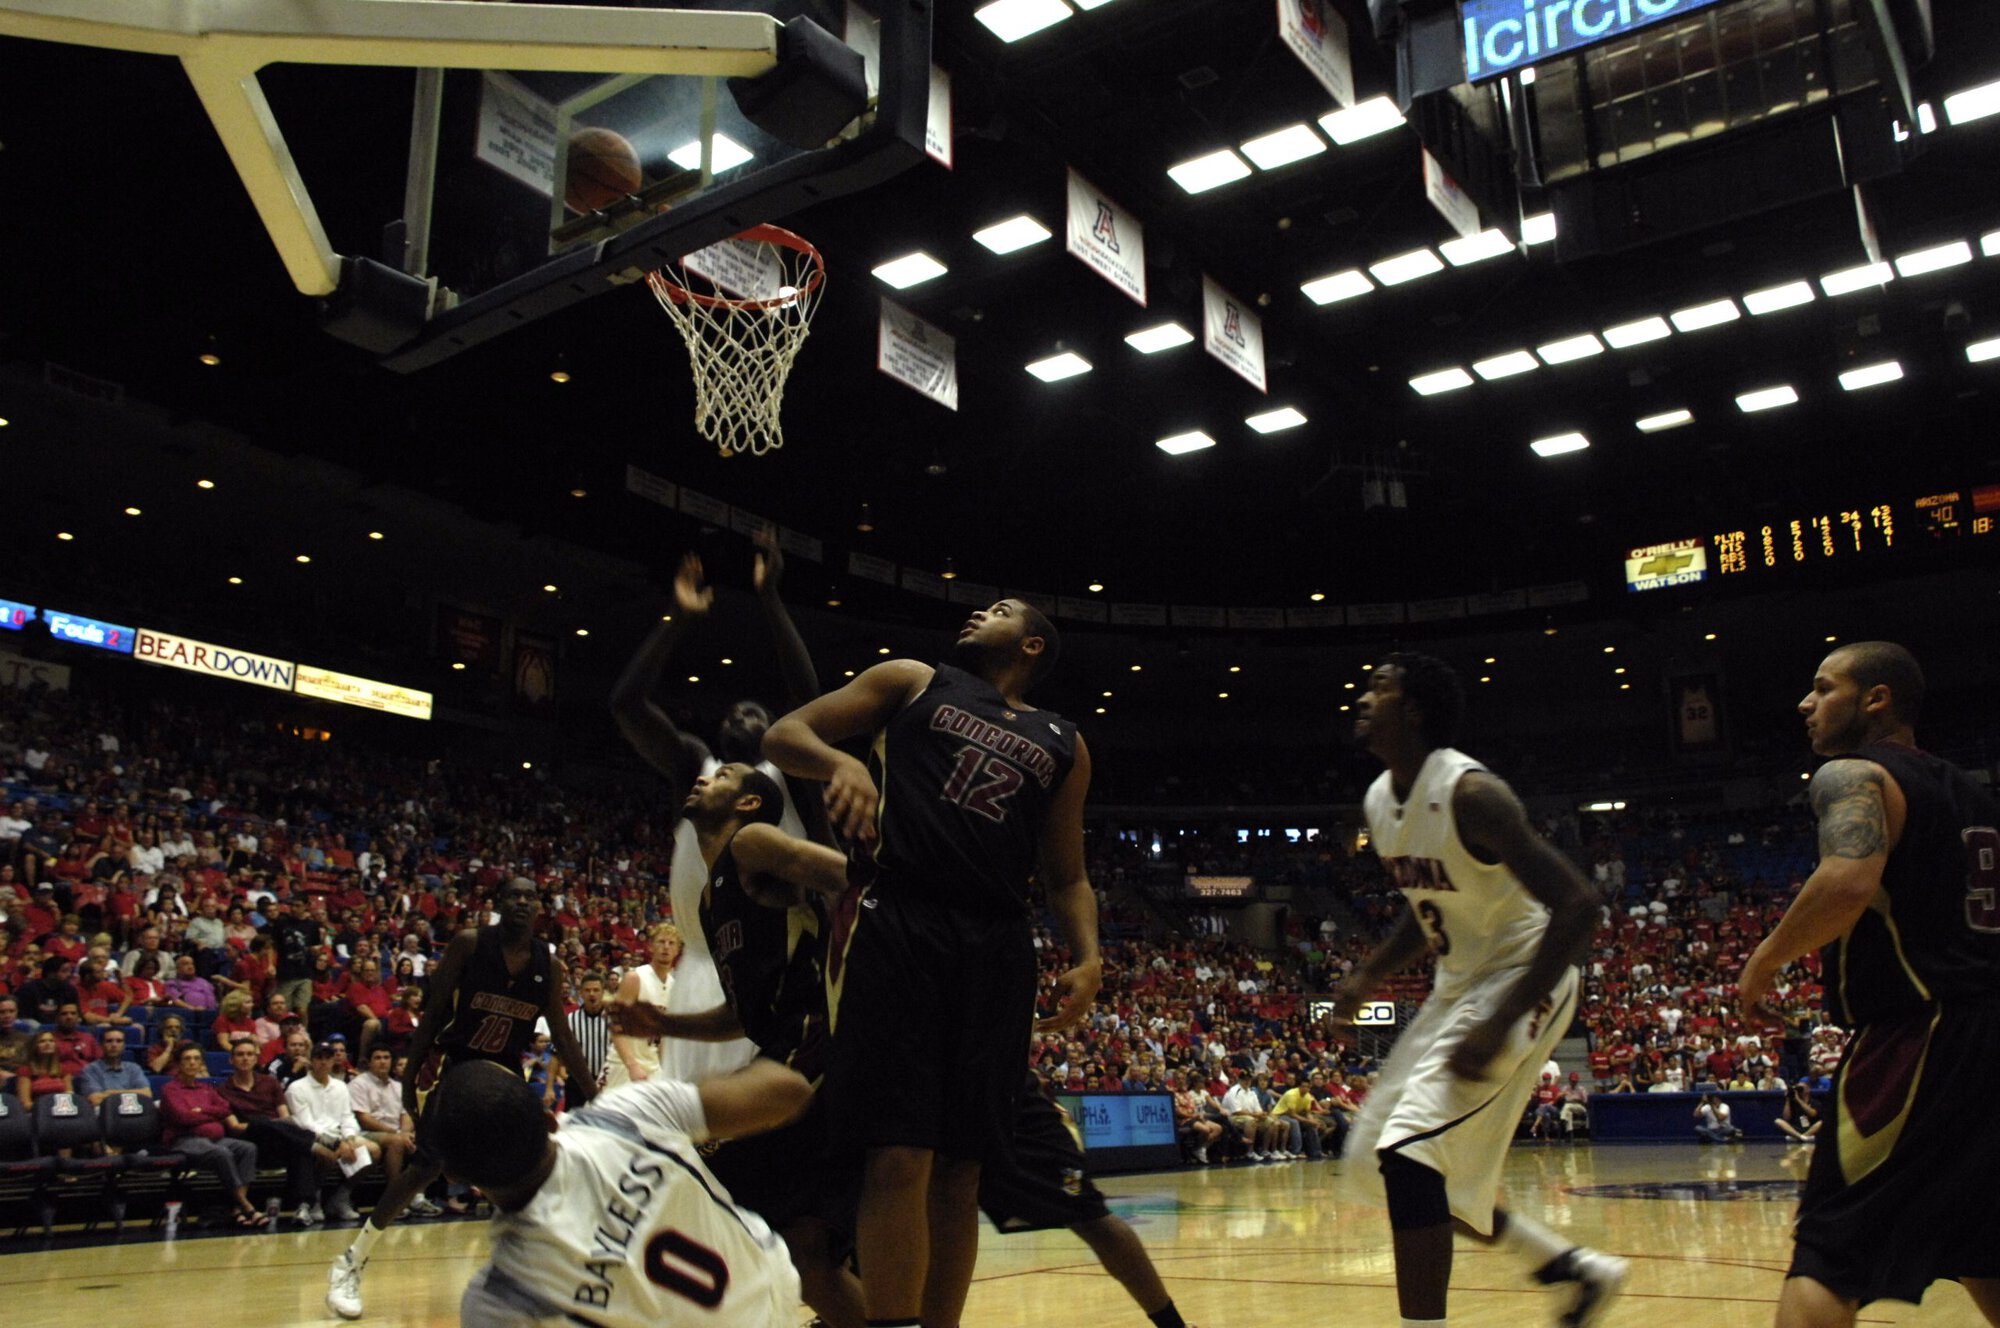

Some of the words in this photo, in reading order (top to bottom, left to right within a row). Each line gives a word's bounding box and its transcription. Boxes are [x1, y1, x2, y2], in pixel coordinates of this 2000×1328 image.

[1093, 201, 1119, 254] A
[1225, 301, 1245, 348] A
[1630, 538, 1697, 559] O'RIELLY
[1634, 571, 1703, 592] WATSON
[50, 615, 105, 644] Fouls
[106, 630, 121, 646] 2
[940, 744, 1024, 823] 12
[1418, 900, 1450, 956] 3
[1136, 1105, 1159, 1124] UPH
[574, 1153, 664, 1308] BAYLESS
[645, 1228, 730, 1310] 0
